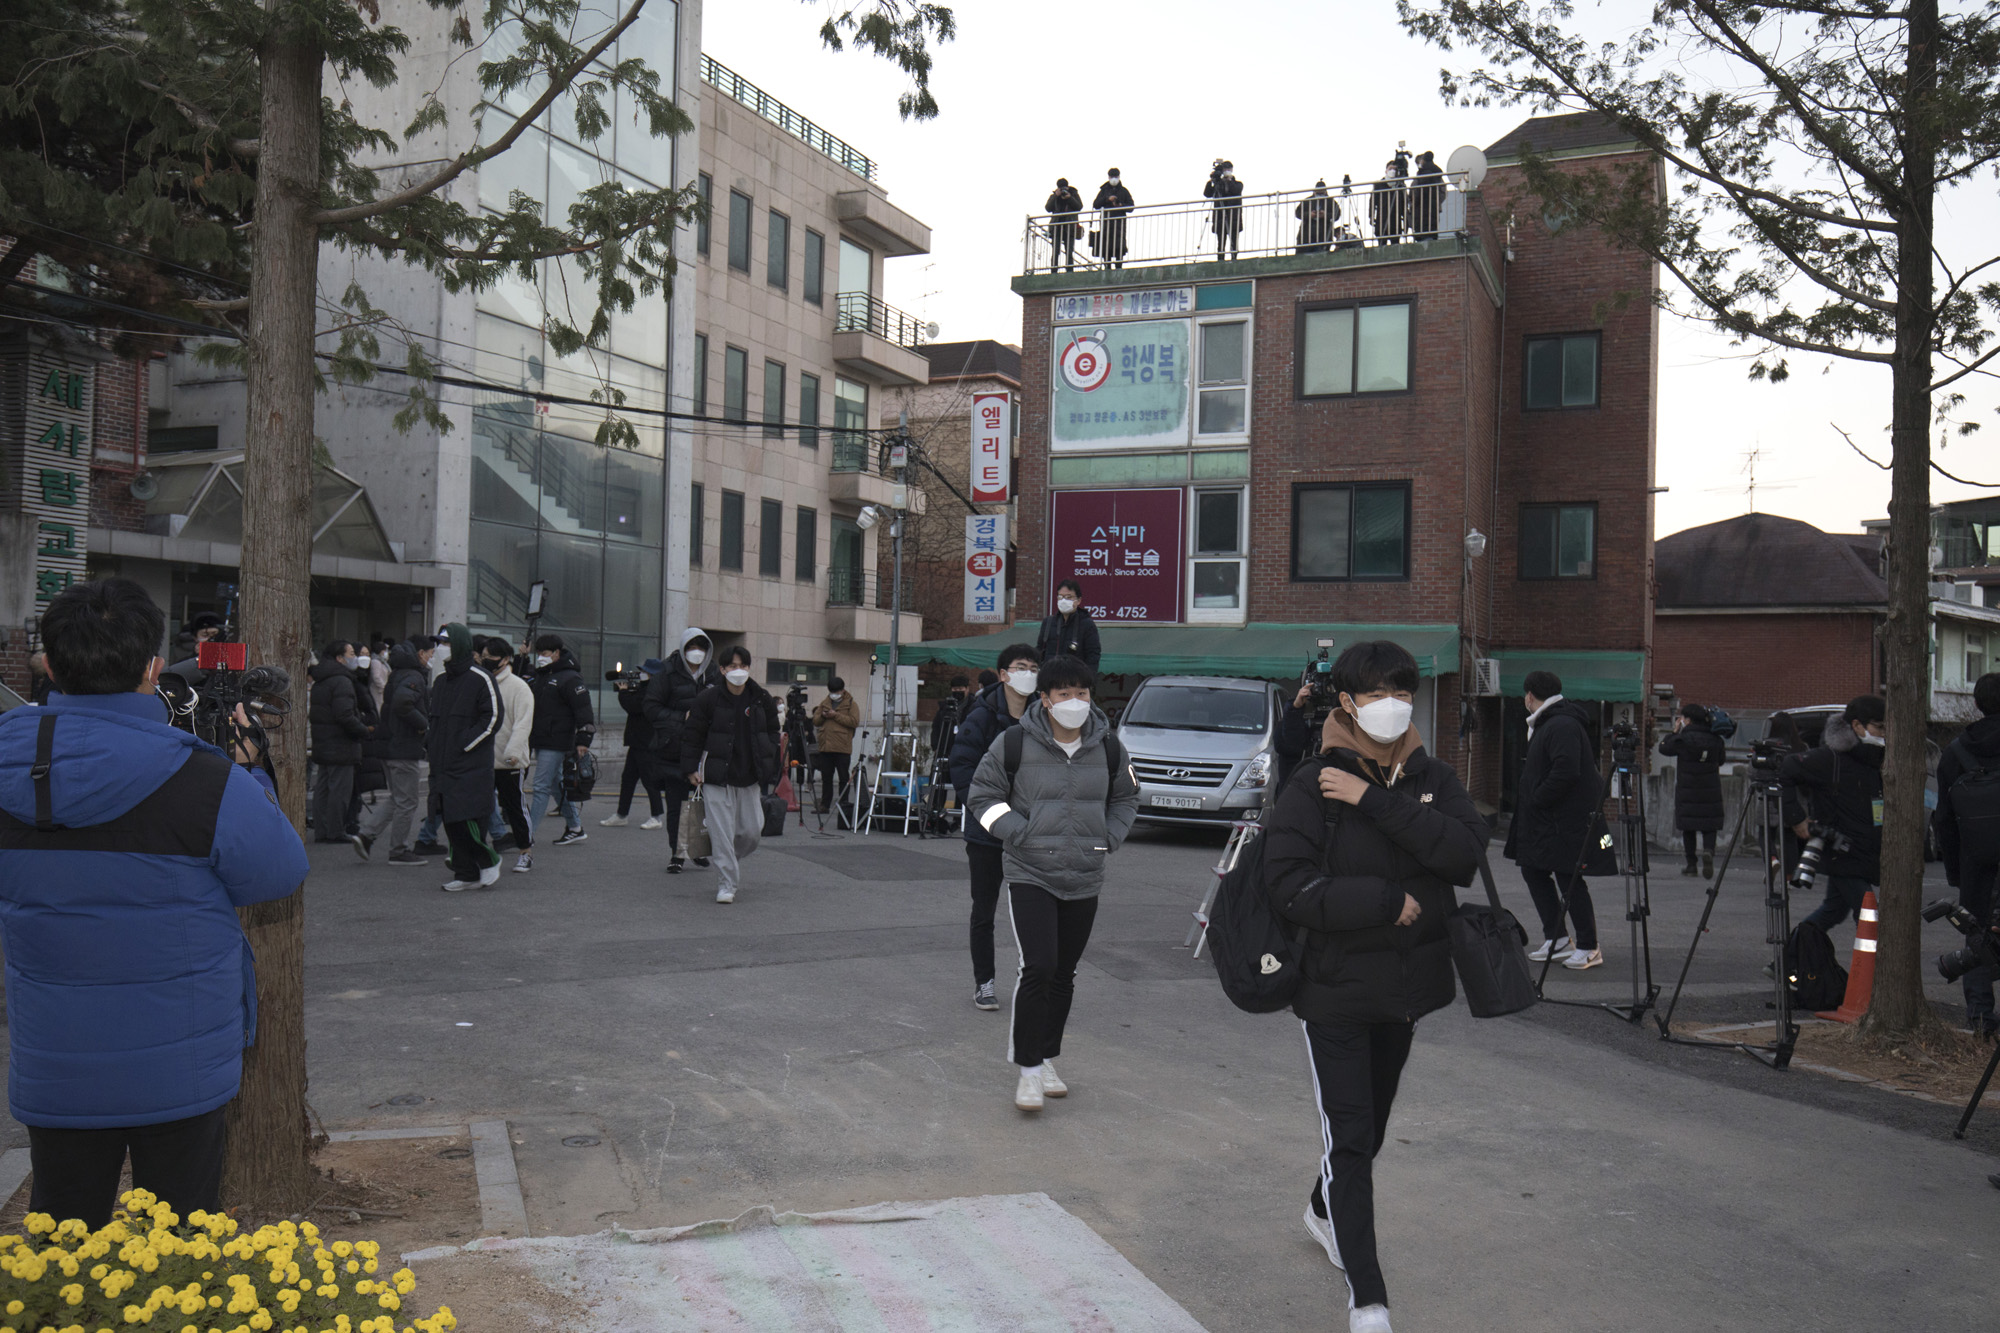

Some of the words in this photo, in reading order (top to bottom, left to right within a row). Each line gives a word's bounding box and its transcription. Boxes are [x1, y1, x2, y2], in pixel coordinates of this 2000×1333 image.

[1056, 296, 1088, 320] 신용과
[1092, 294, 1124, 317] 품질을
[1166, 290, 1188, 312] 하는
[1079, 357, 1092, 371] e
[1121, 343, 1174, 384] 학생복
[981, 406, 1000, 486] 엘리트
[36, 368, 88, 601] 새사람교회
[1090, 525, 1146, 543] 스키마
[1074, 548, 1109, 566] 국어
[1124, 548, 1160, 566] 논술
[1114, 568, 1136, 576] Since
[1137, 568, 1160, 576] 2006
[1175, 798, 1197, 808] 9017
